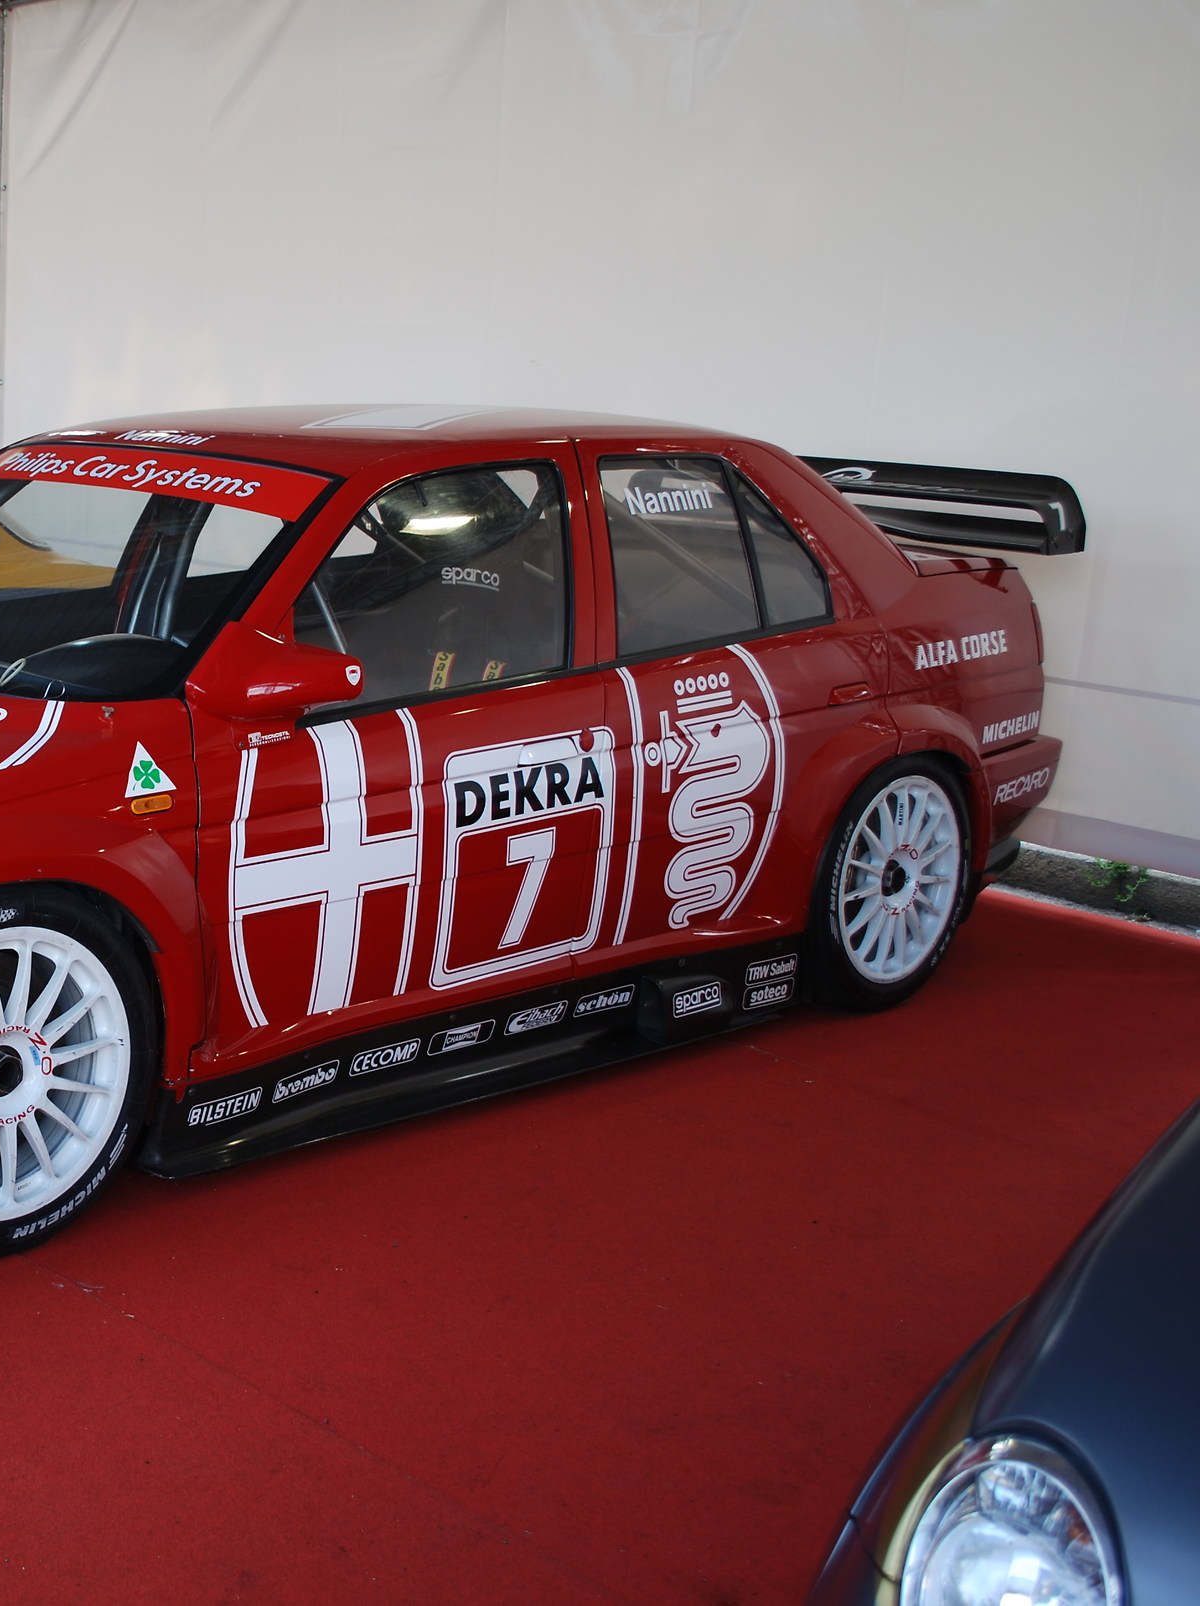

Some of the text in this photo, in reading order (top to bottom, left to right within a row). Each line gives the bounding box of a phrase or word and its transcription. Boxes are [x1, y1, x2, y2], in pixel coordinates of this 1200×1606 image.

[73, 455, 129, 479] Car
[122, 459, 261, 497] Systems
[624, 482, 712, 515] Nannini
[441, 566, 500, 587] sparco
[914, 630, 1007, 671] ALFA CORSE
[982, 711, 1040, 744] MICHELIN
[454, 757, 604, 828] DEKRA
[993, 767, 1050, 805] RECARO
[830, 821, 853, 911] MICHELIN
[497, 827, 556, 949] 7
[748, 958, 795, 981] TRW Sabelt
[576, 991, 631, 1013] schön
[675, 985, 719, 1012] sparco
[749, 983, 787, 1003] soteco
[508, 1002, 564, 1033] Eibach
[446, 1029, 478, 1045] CHAMPION
[353, 1042, 418, 1073] CECOMP
[274, 1067, 336, 1101] brembo
[189, 1091, 261, 1126] BILSTEIN
[12, 1166, 106, 1239] MICHELIN
